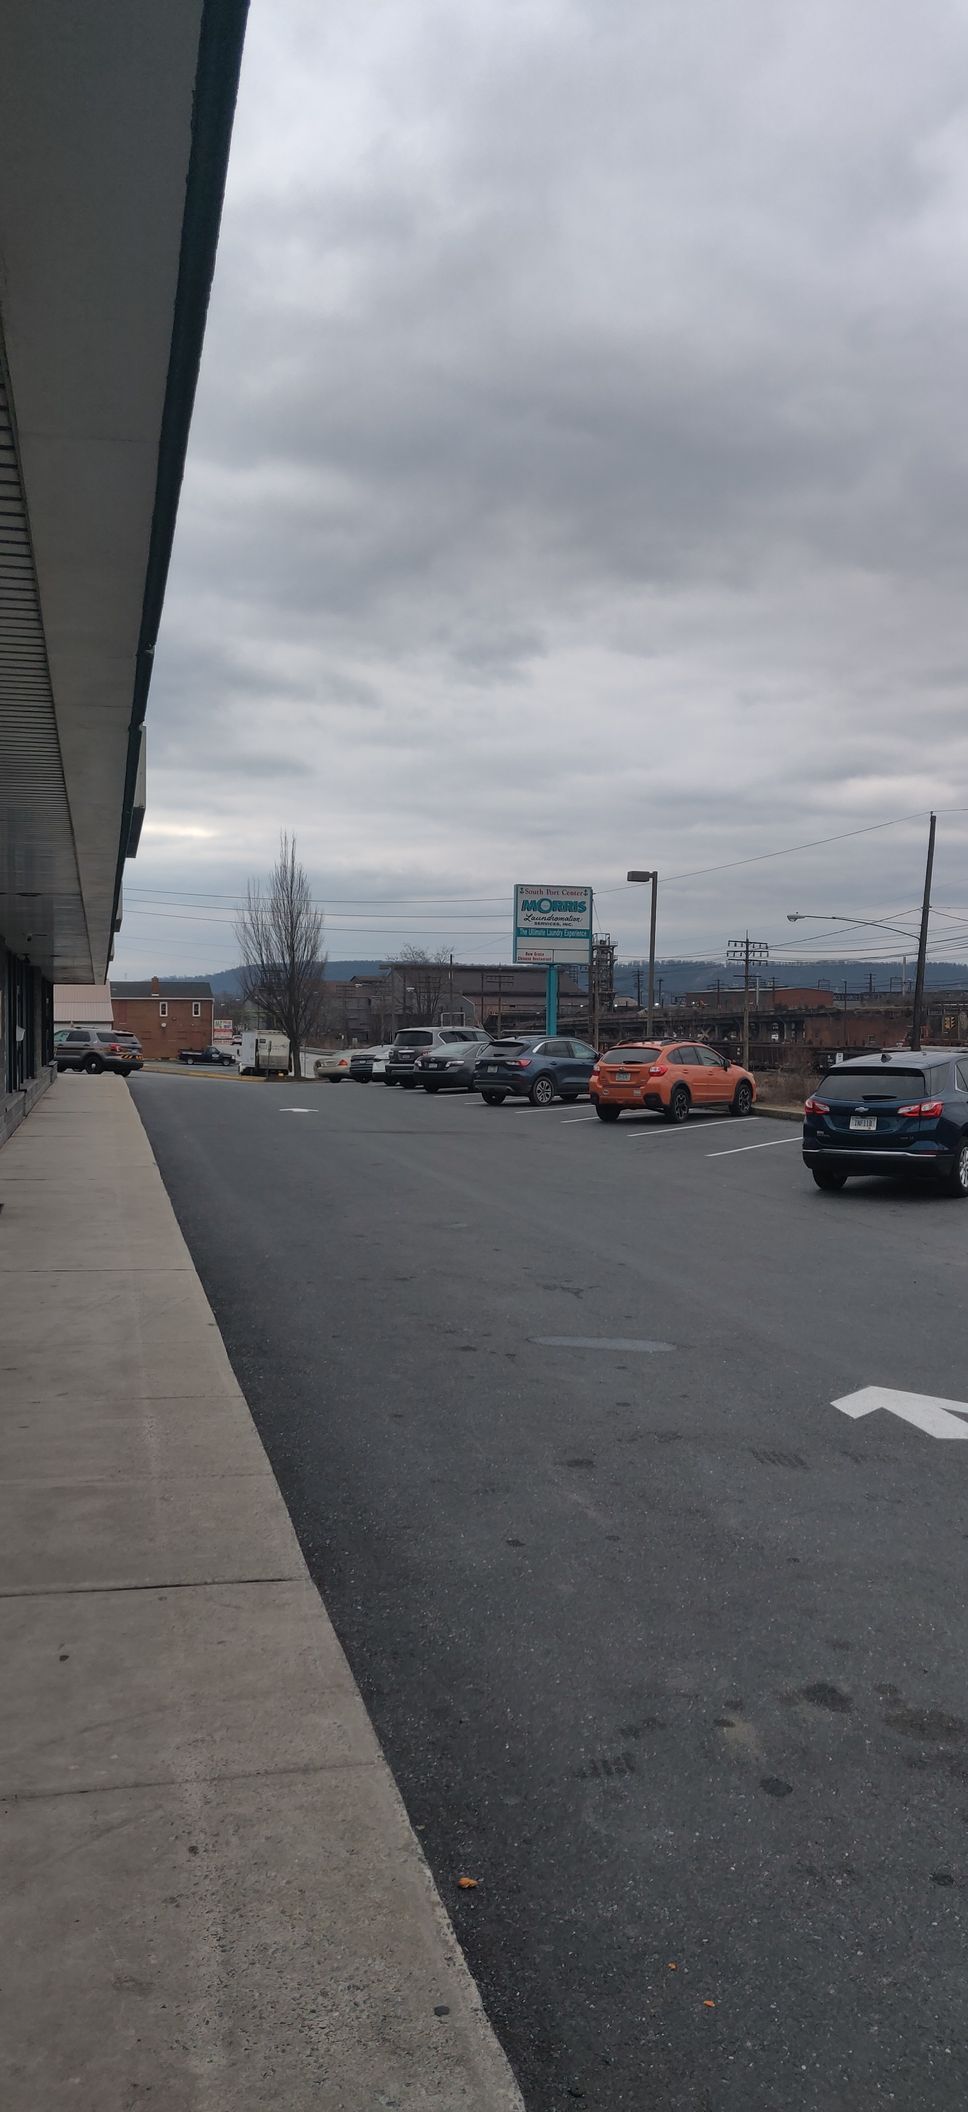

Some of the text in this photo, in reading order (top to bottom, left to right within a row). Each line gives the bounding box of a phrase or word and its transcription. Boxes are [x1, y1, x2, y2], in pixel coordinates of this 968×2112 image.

[546, 888, 559, 896] Port
[521, 898, 587, 914] MORRIS
[528, 928, 546, 936] Ultimate
[546, 928, 563, 937] Laundry
[564, 929, 587, 937] Experience
